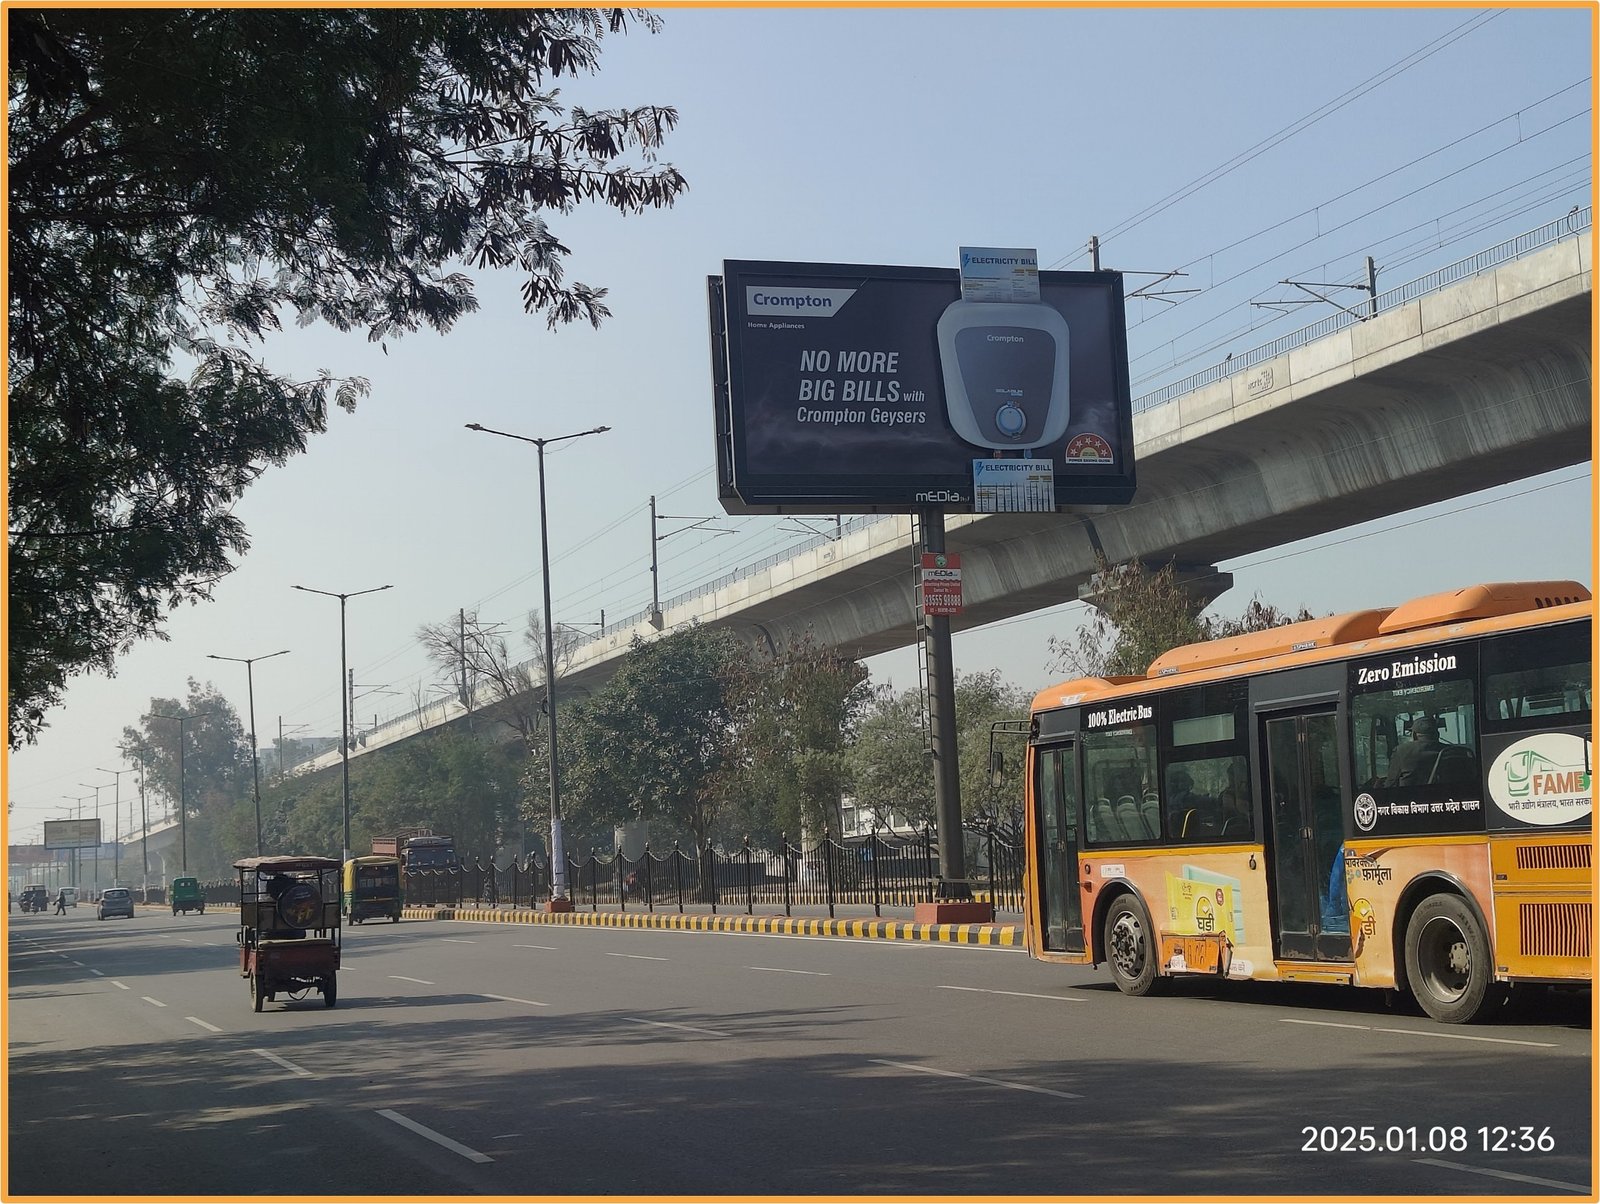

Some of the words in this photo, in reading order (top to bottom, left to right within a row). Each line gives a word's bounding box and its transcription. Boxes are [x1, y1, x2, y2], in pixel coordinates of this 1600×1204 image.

[972, 257, 1019, 265] ELECTRICITY
[1021, 258, 1037, 266] BILL
[753, 293, 832, 309] Crompton
[769, 322, 805, 330] Appliances
[986, 334, 1024, 343] Crompton
[800, 351, 831, 372] NO
[837, 351, 899, 373] MORE
[799, 379, 836, 401] BIG
[842, 380, 901, 402] BILLS
[903, 391, 925, 402] with
[797, 406, 866, 426] Crompton
[870, 407, 926, 426] Geysers
[985, 464, 1033, 472] ELECTRICITY
[1035, 464, 1052, 472] BILL
[1358, 667, 1390, 685] Zero
[1391, 652, 1457, 679] Emission
[1088, 711, 1108, 728] 100%
[1108, 707, 1138, 725] Electric
[1137, 704, 1153, 719] Bus
[1533, 771, 1585, 795] FAME
[1377, 806, 1390, 816] नगर
[1391, 803, 1410, 815] विकास
[1410, 801, 1429, 814] विभाग
[1430, 802, 1444, 813] उत्तर
[1445, 798, 1460, 814] प्रदेश
[1461, 800, 1480, 811] शासन
[1575, 797, 1592, 806] सरका
